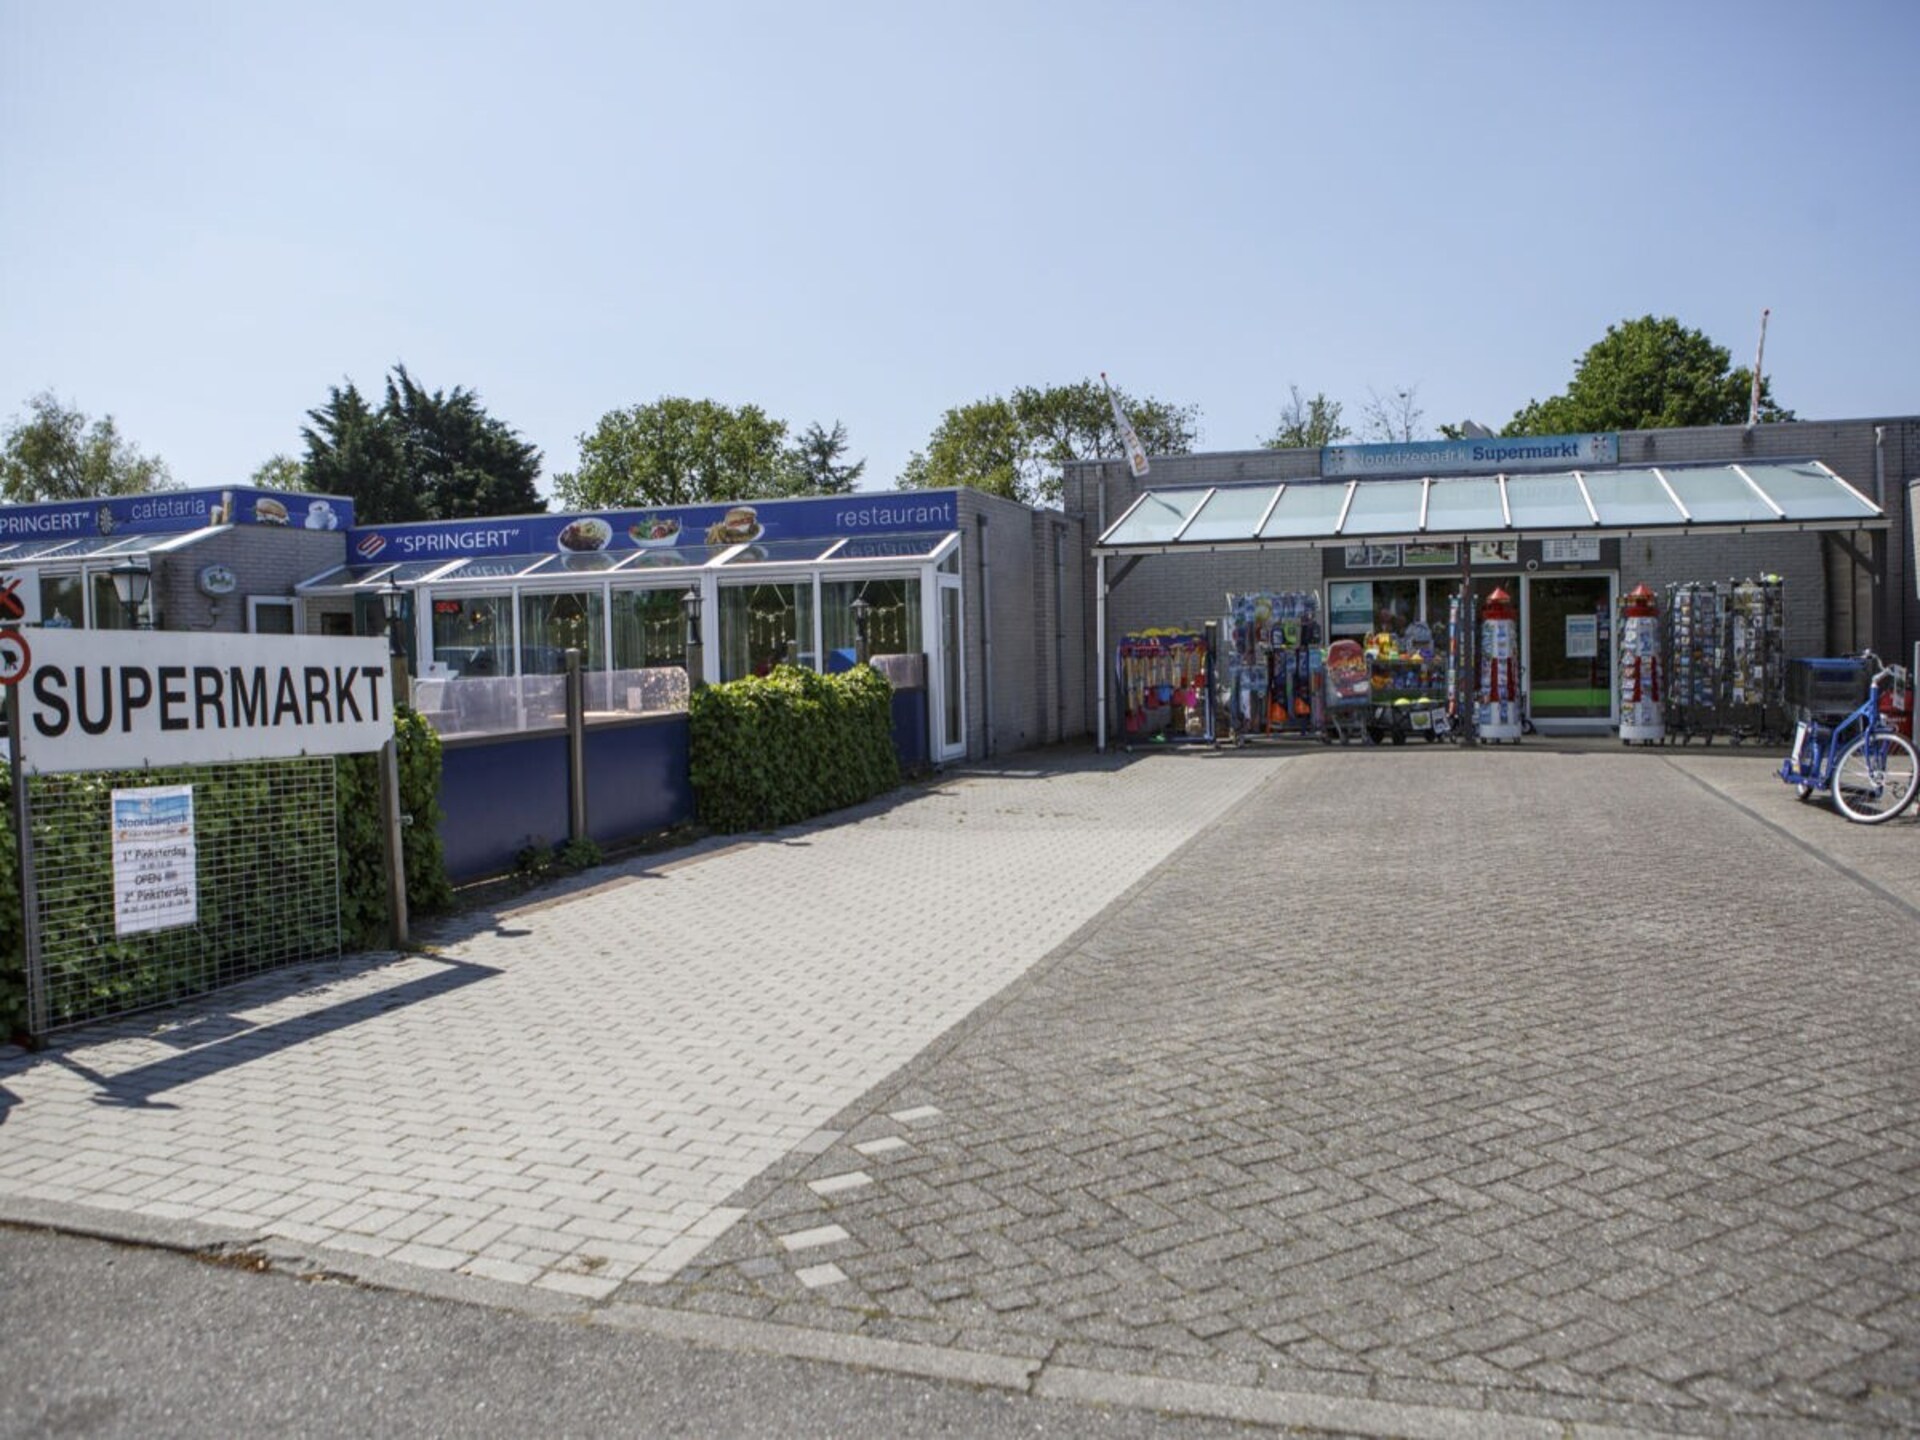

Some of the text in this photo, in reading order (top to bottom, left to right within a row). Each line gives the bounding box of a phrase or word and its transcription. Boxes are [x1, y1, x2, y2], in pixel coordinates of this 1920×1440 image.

[1472, 442, 1579, 462] Supermarkt
[131, 497, 206, 519] cafetaria
[836, 502, 950, 527] restaurant
[395, 528, 519, 552] "SPRINGERT"
[33, 664, 385, 737] SUPERMARKT
